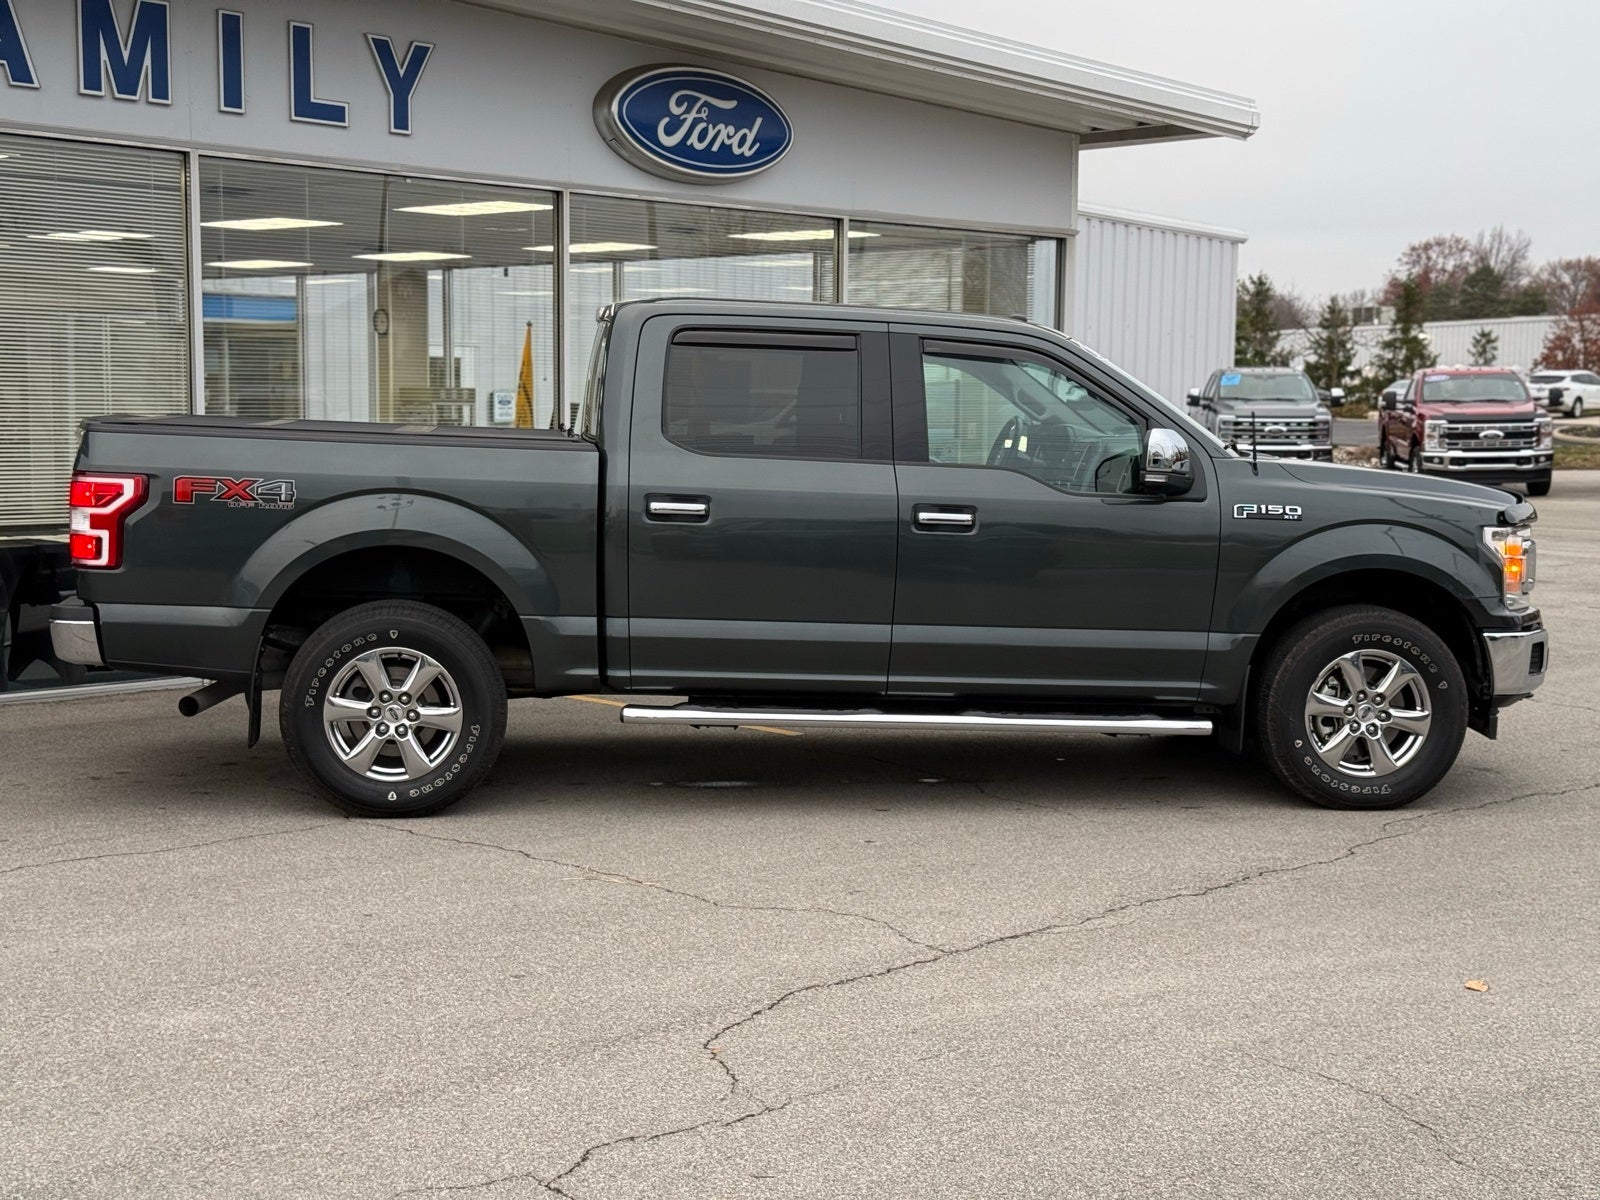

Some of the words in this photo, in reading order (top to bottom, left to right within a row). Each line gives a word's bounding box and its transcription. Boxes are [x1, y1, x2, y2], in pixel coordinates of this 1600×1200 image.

[657, 89, 763, 157] Ford
[172, 475, 297, 504] FX4
[304, 633, 378, 708] Firestone
[1352, 633, 1438, 674] Firestone
[409, 724, 481, 798] Firestone
